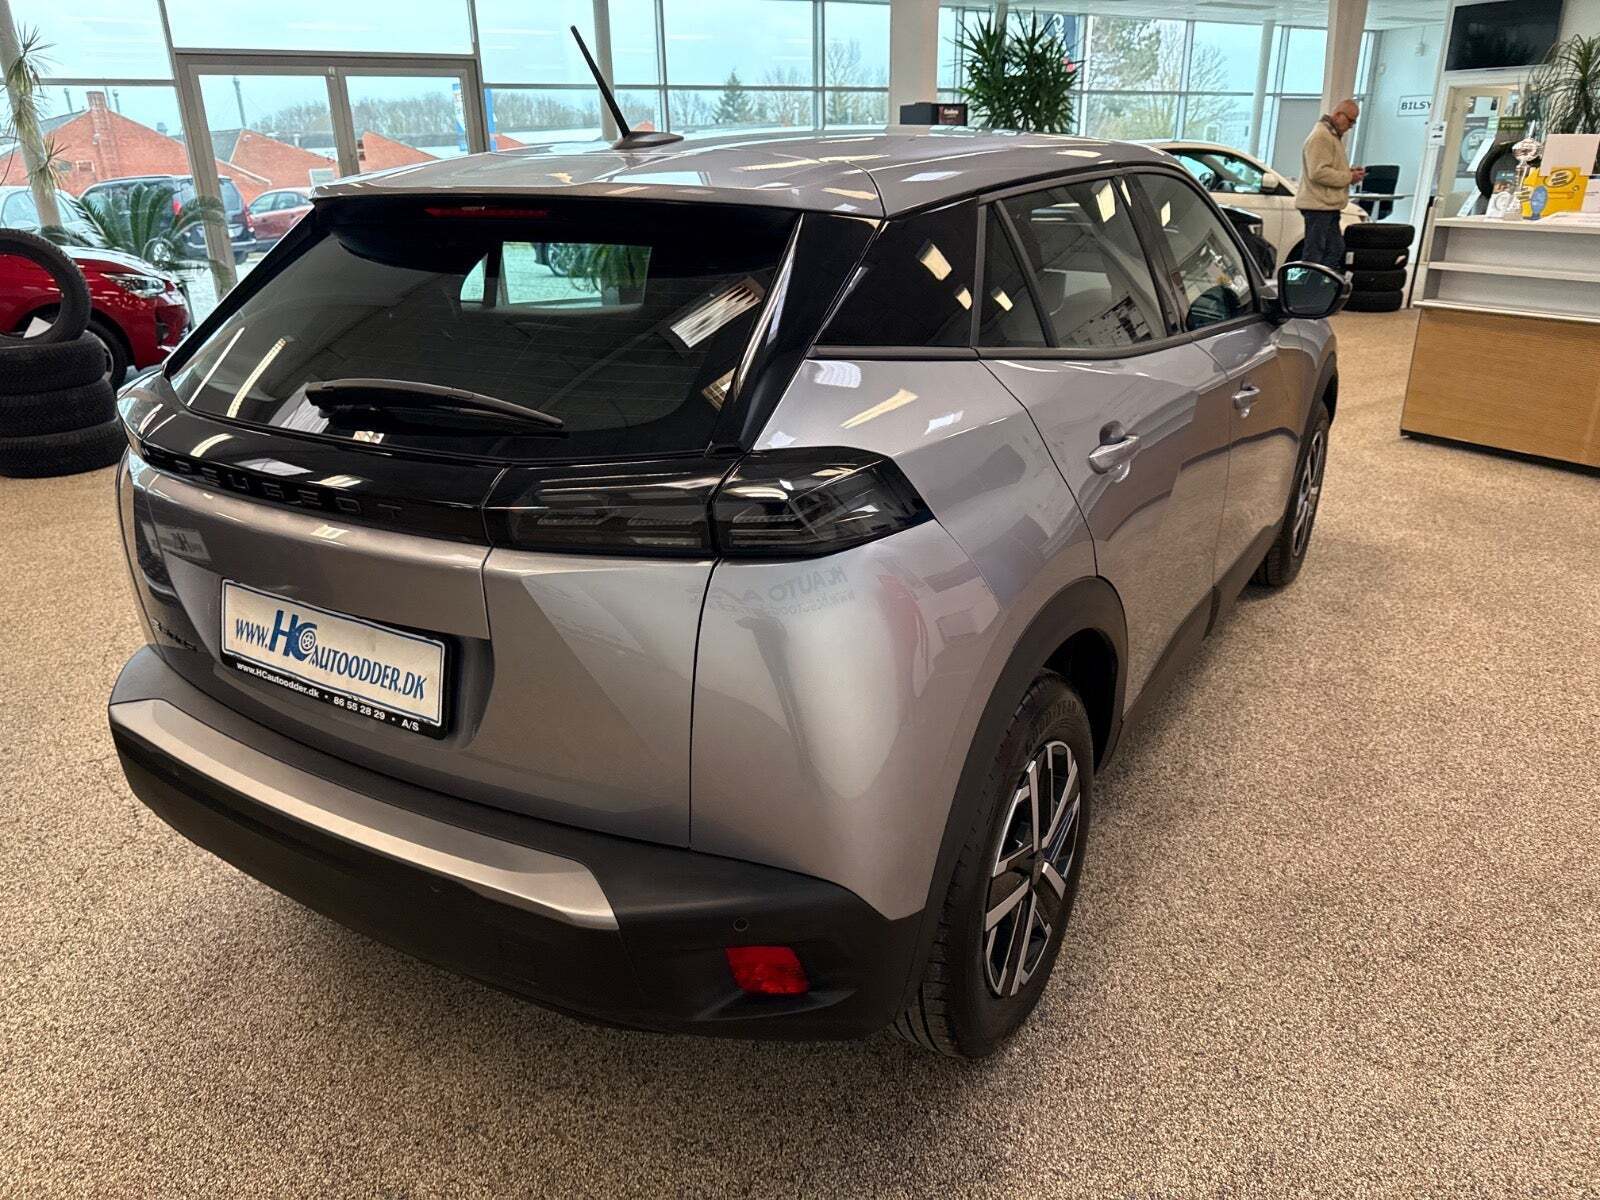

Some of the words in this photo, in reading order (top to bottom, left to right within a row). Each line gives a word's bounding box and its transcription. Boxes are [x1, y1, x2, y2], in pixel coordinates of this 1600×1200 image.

[236, 662, 320, 698] www.HCautoodder.dk
[346, 700, 358, 711] 55
[359, 705, 372, 716] 28
[373, 709, 386, 720] 29
[401, 718, 420, 732] A/S
